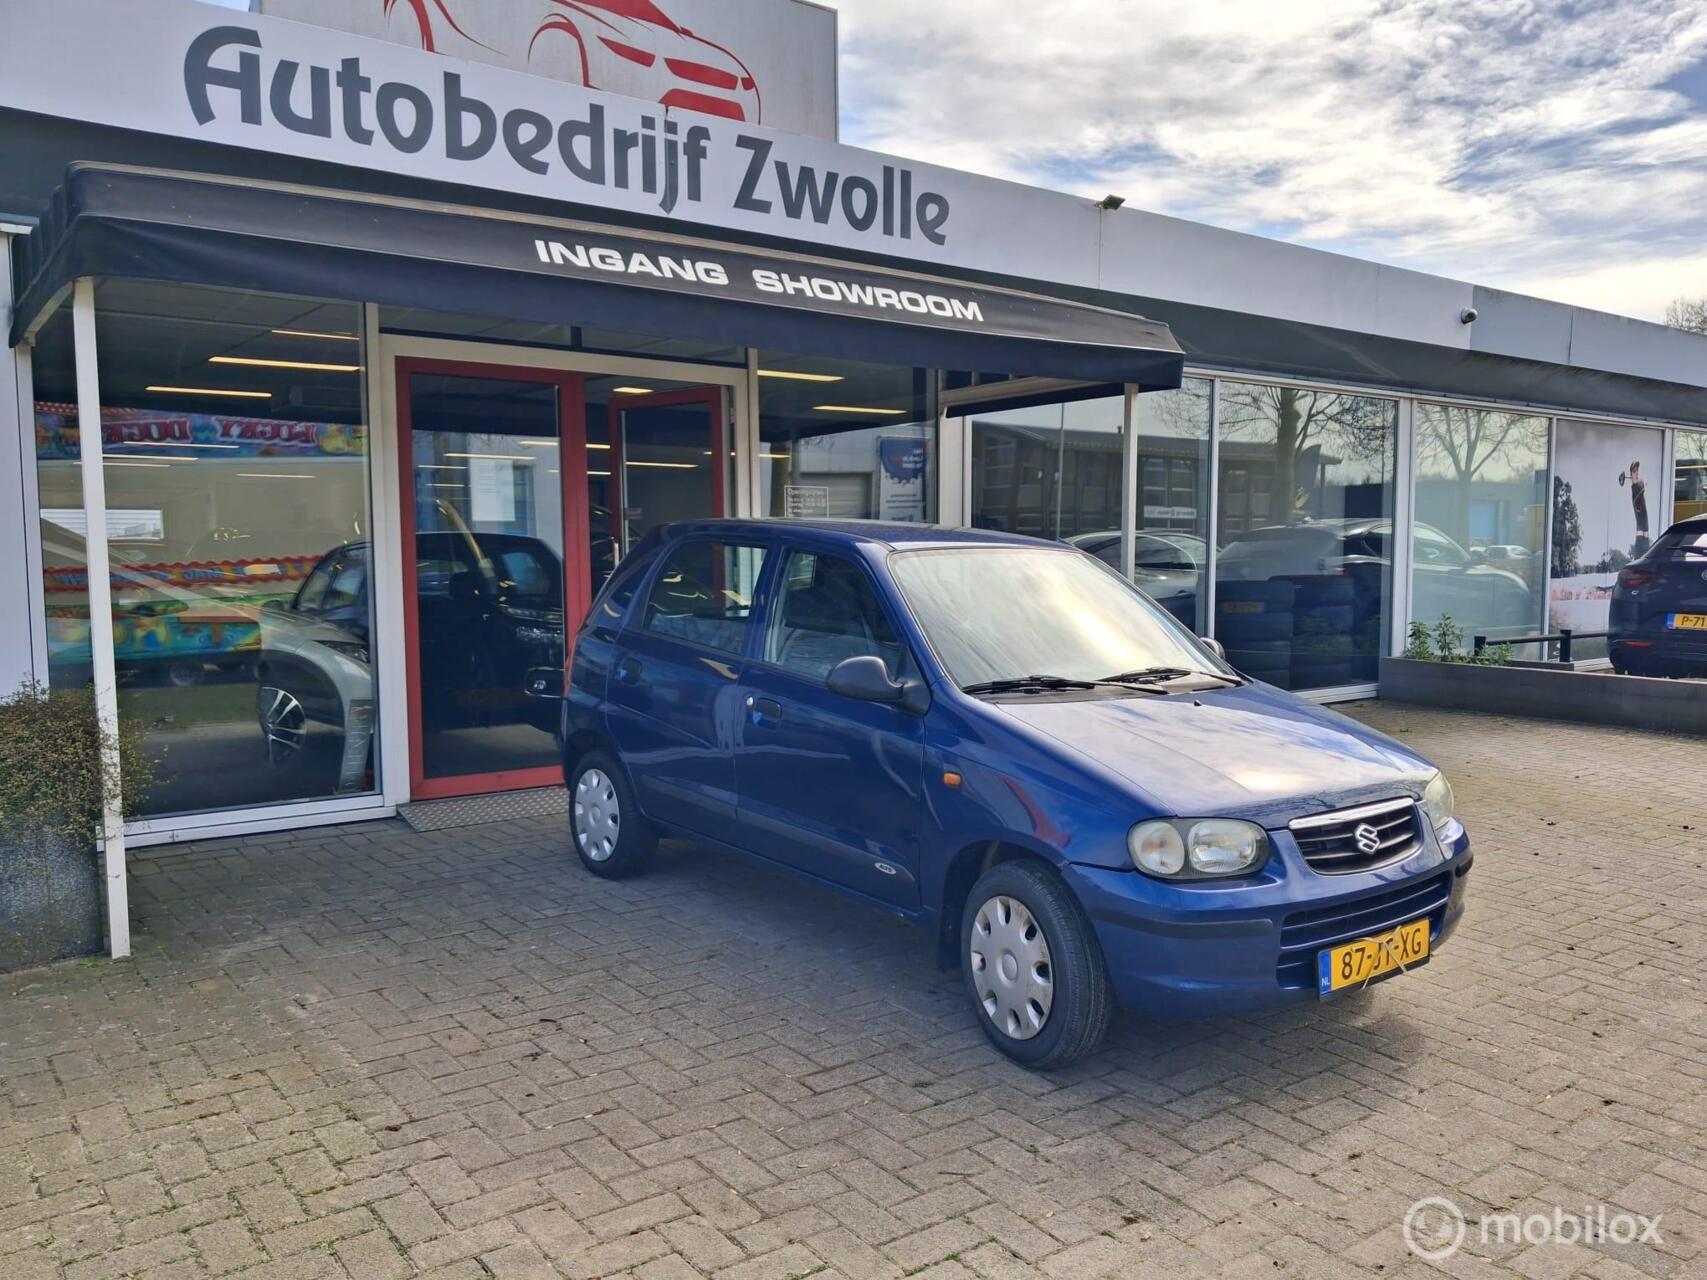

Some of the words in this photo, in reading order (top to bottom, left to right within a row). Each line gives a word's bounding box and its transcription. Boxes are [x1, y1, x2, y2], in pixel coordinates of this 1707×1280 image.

[183, 25, 711, 214] Autobedrijf
[733, 134, 950, 245] Zwolle
[534, 240, 729, 286] INGANG
[752, 271, 984, 322] SHOWROOM
[1321, 977, 1330, 986] NL
